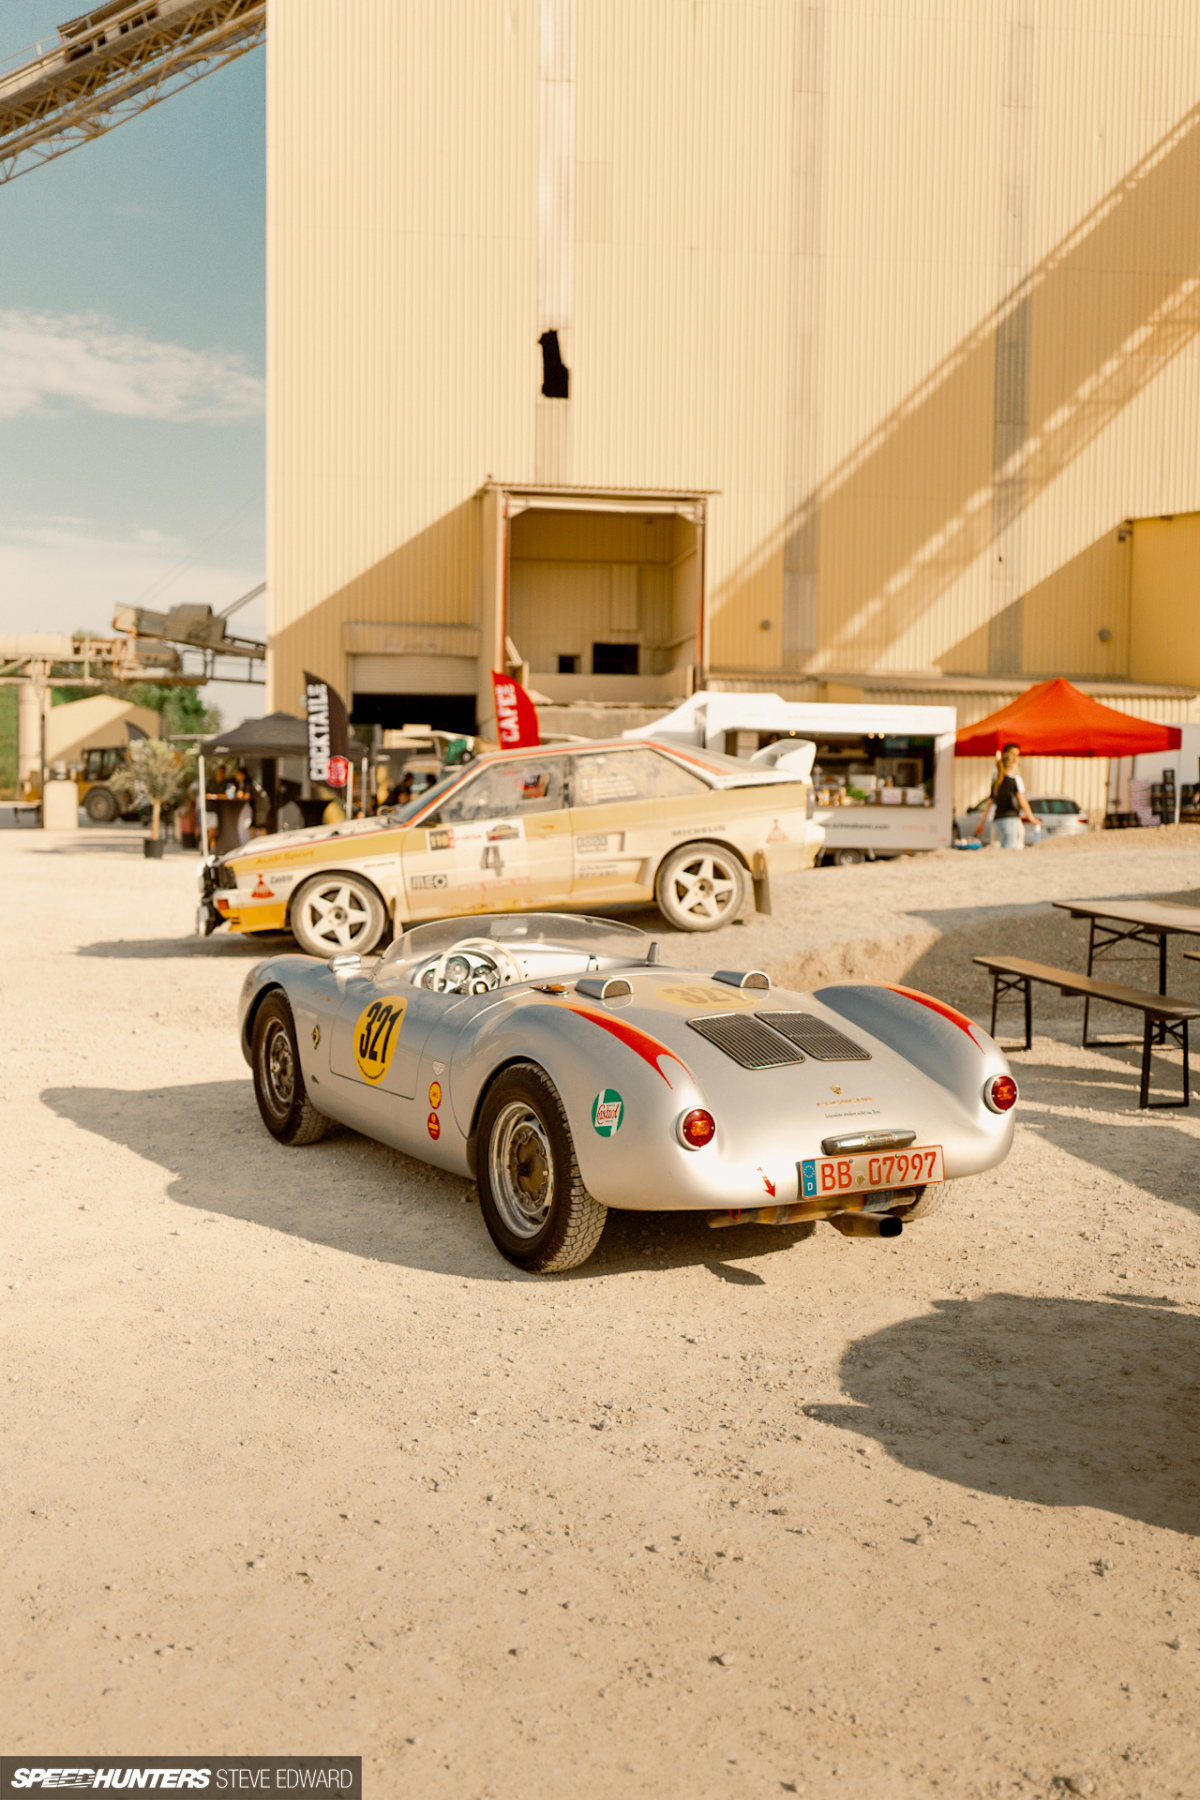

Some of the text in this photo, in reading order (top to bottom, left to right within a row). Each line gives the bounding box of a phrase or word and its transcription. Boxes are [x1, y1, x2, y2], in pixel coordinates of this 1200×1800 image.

[307, 684, 330, 781] COCKTAILS
[480, 845, 505, 877] 4
[660, 986, 746, 1004] 321
[359, 1001, 404, 1064] 321
[807, 1182, 814, 1191] D
[820, 1151, 937, 1191] BB 07997
